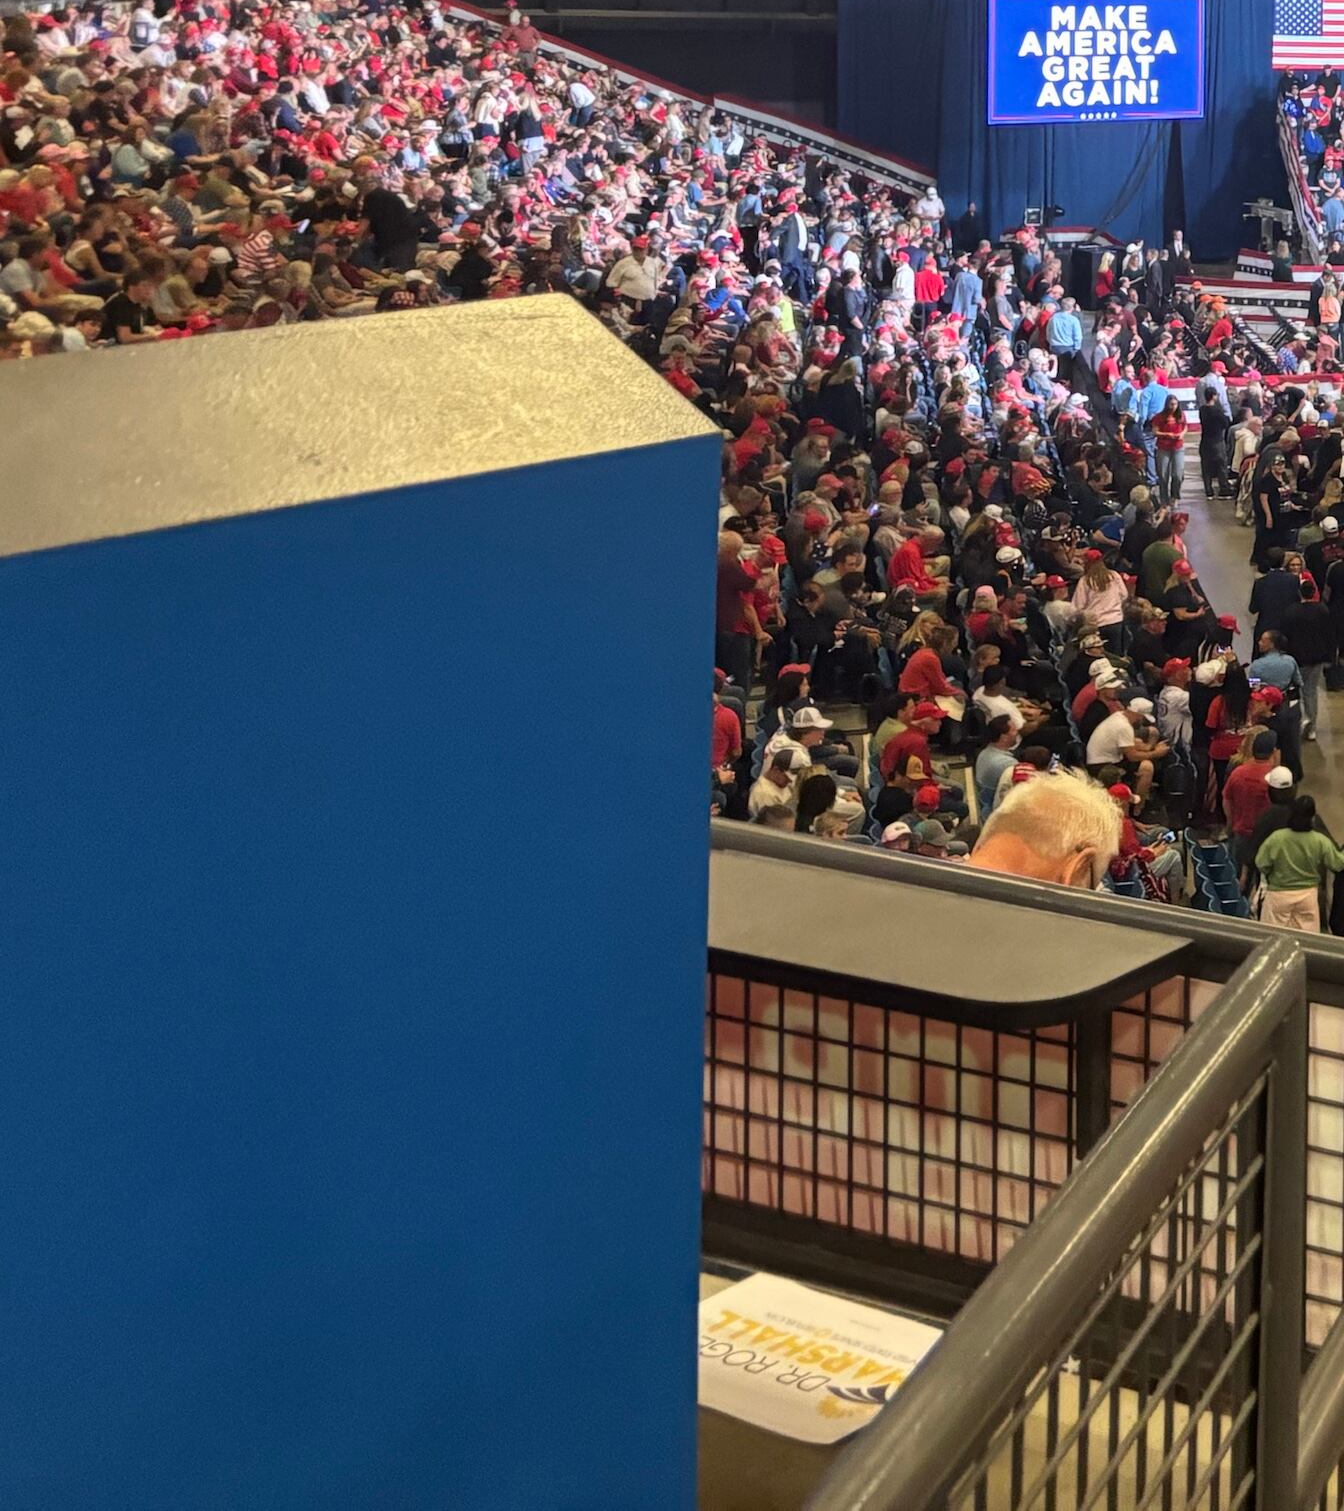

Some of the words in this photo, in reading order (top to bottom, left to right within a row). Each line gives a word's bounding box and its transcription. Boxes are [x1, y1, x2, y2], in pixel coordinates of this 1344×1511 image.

[1051, 5, 1148, 31] MAKE
[1018, 30, 1177, 57] AMERICA
[1041, 55, 1155, 82] GREAT
[1036, 80, 1160, 107] AGAIN!
[776, 1364, 832, 1392] DR.
